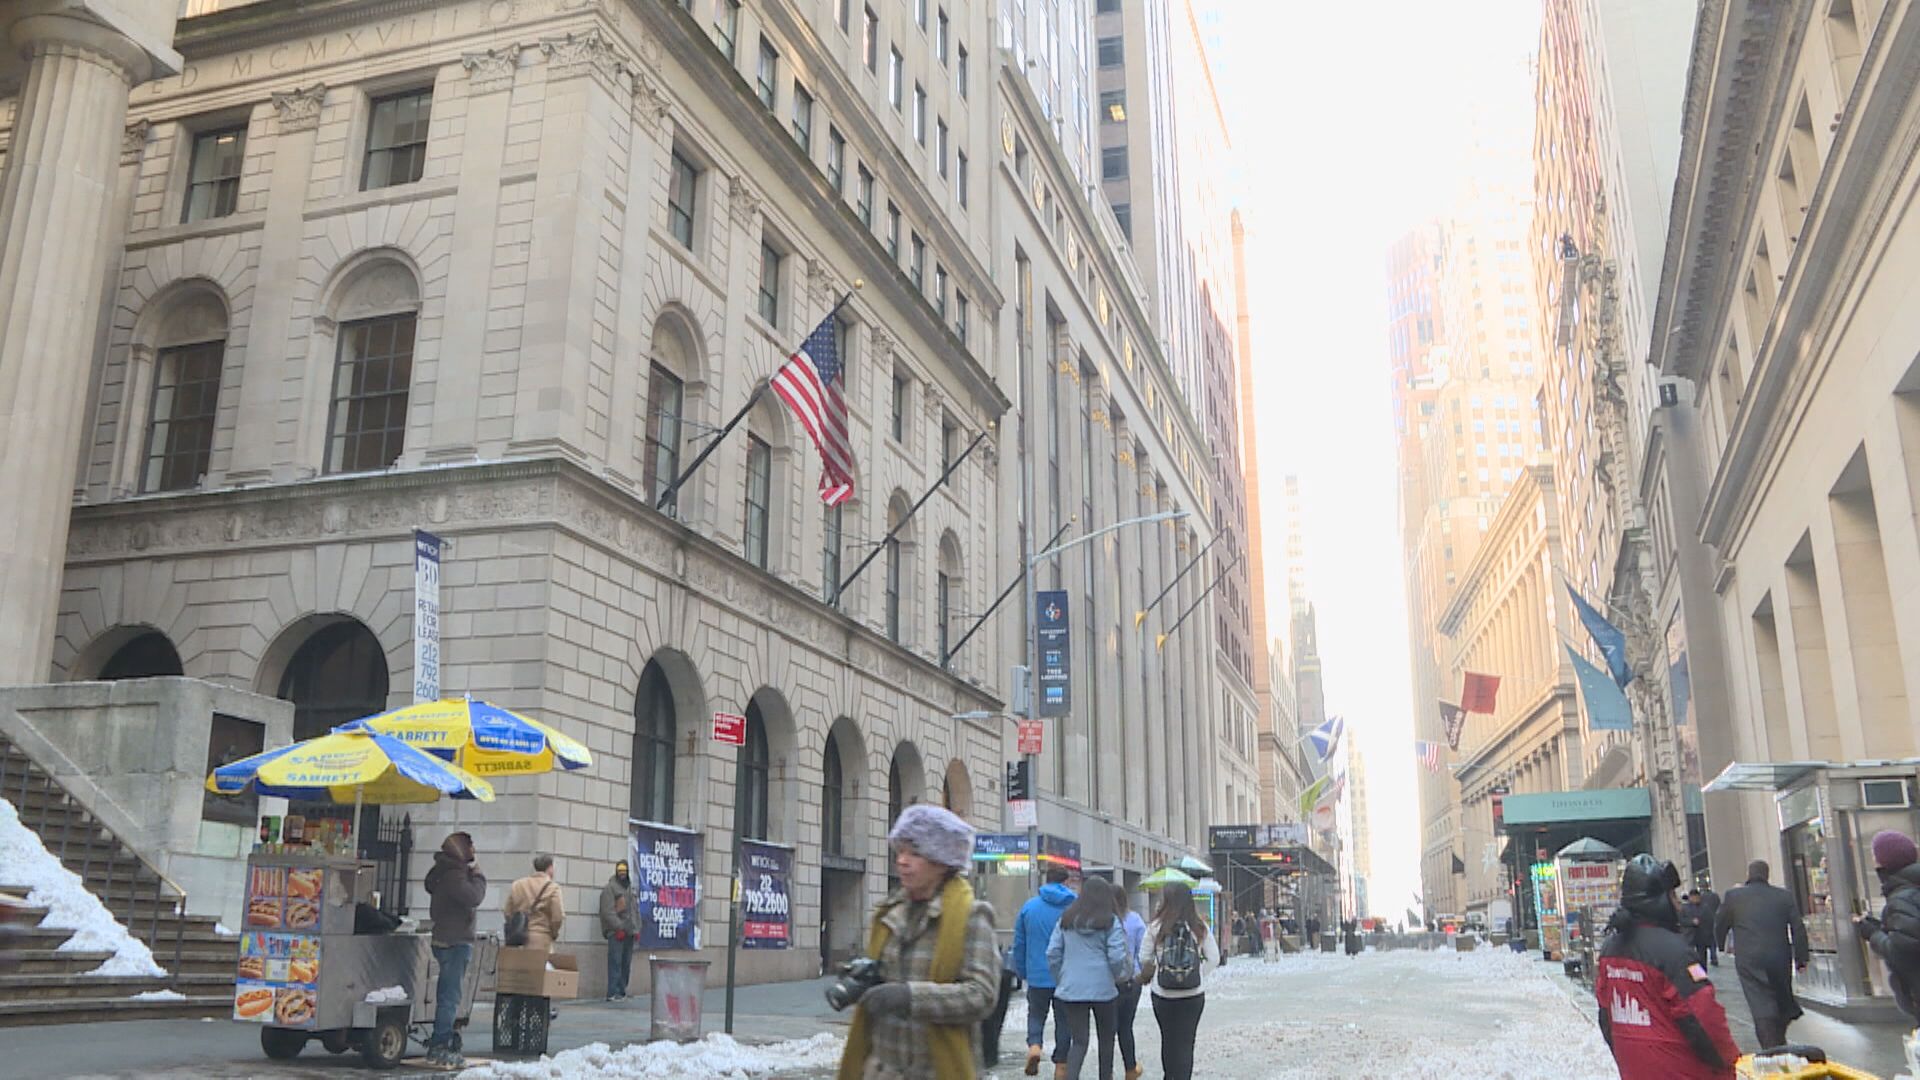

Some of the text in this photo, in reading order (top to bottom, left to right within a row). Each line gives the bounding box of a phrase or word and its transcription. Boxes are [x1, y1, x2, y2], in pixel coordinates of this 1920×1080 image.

[422, 613, 437, 628] FOR
[418, 627, 439, 643] LEASE
[421, 644, 438, 664] 212
[421, 663, 437, 682] 792
[416, 681, 439, 700] 2600
[286, 771, 361, 782] SABRETT
[655, 840, 680, 858] PRIME
[640, 853, 694, 874] RETAIL SPACE
[646, 870, 689, 888] FOR LEASE
[760, 874, 772, 892] 212
[652, 907, 684, 924] SQUARE
[658, 923, 679, 938] FEET
